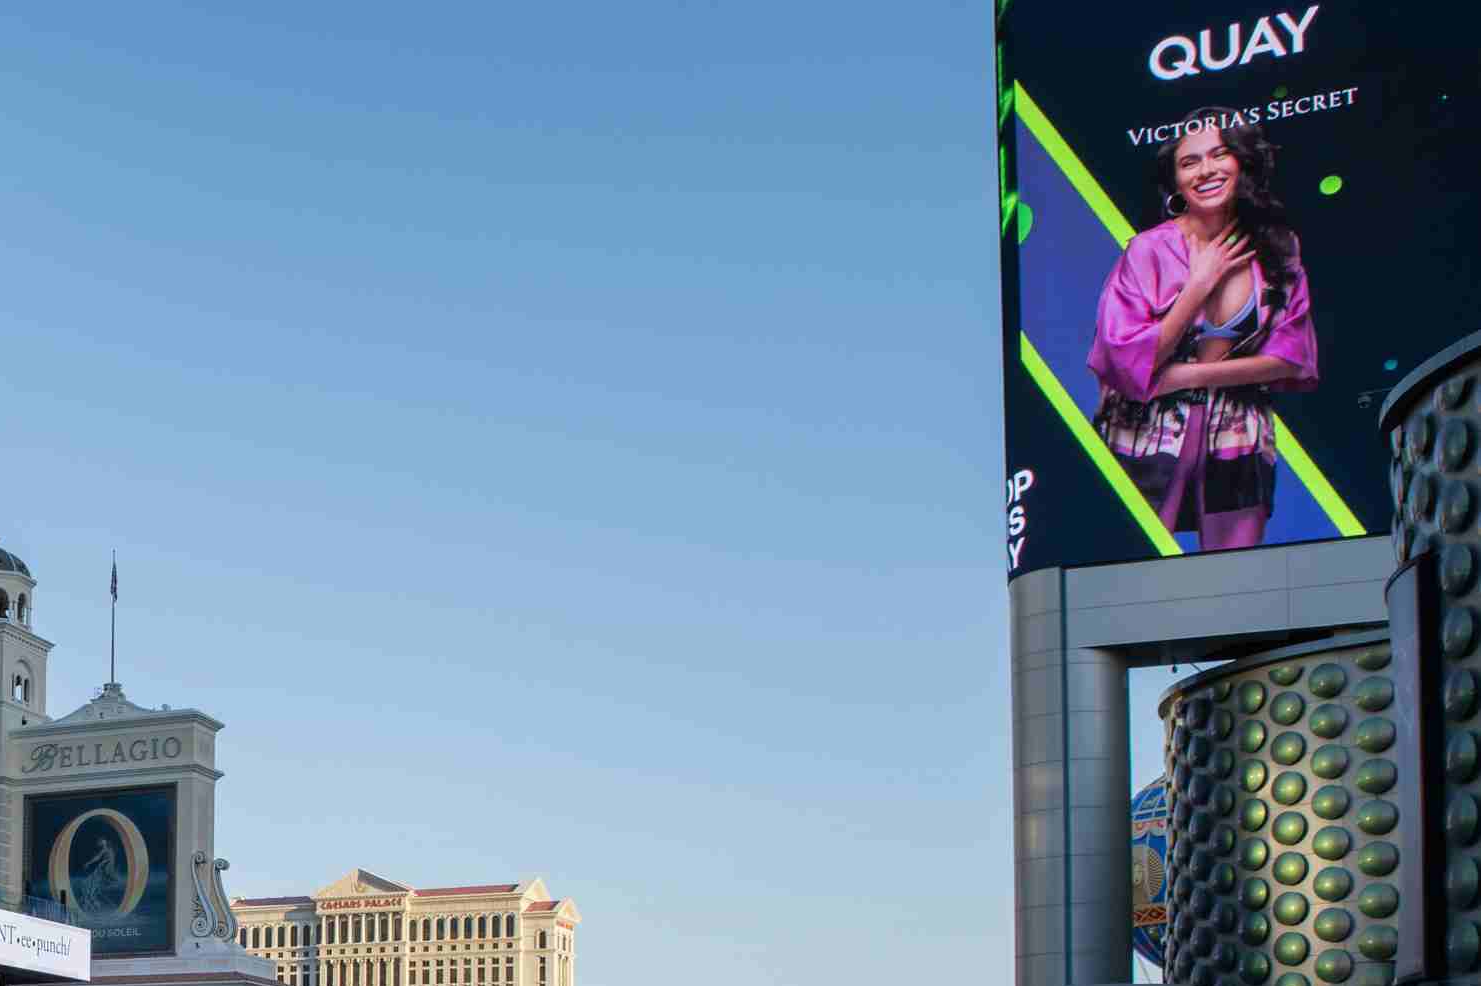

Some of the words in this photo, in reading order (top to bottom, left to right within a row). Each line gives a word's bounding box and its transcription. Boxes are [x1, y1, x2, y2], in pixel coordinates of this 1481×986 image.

[1148, 5, 1319, 81] QUAY
[1127, 107, 1261, 147] VICTORIA'S
[1266, 87, 1359, 121] SECRET
[22, 736, 182, 773] BELLAGIO
